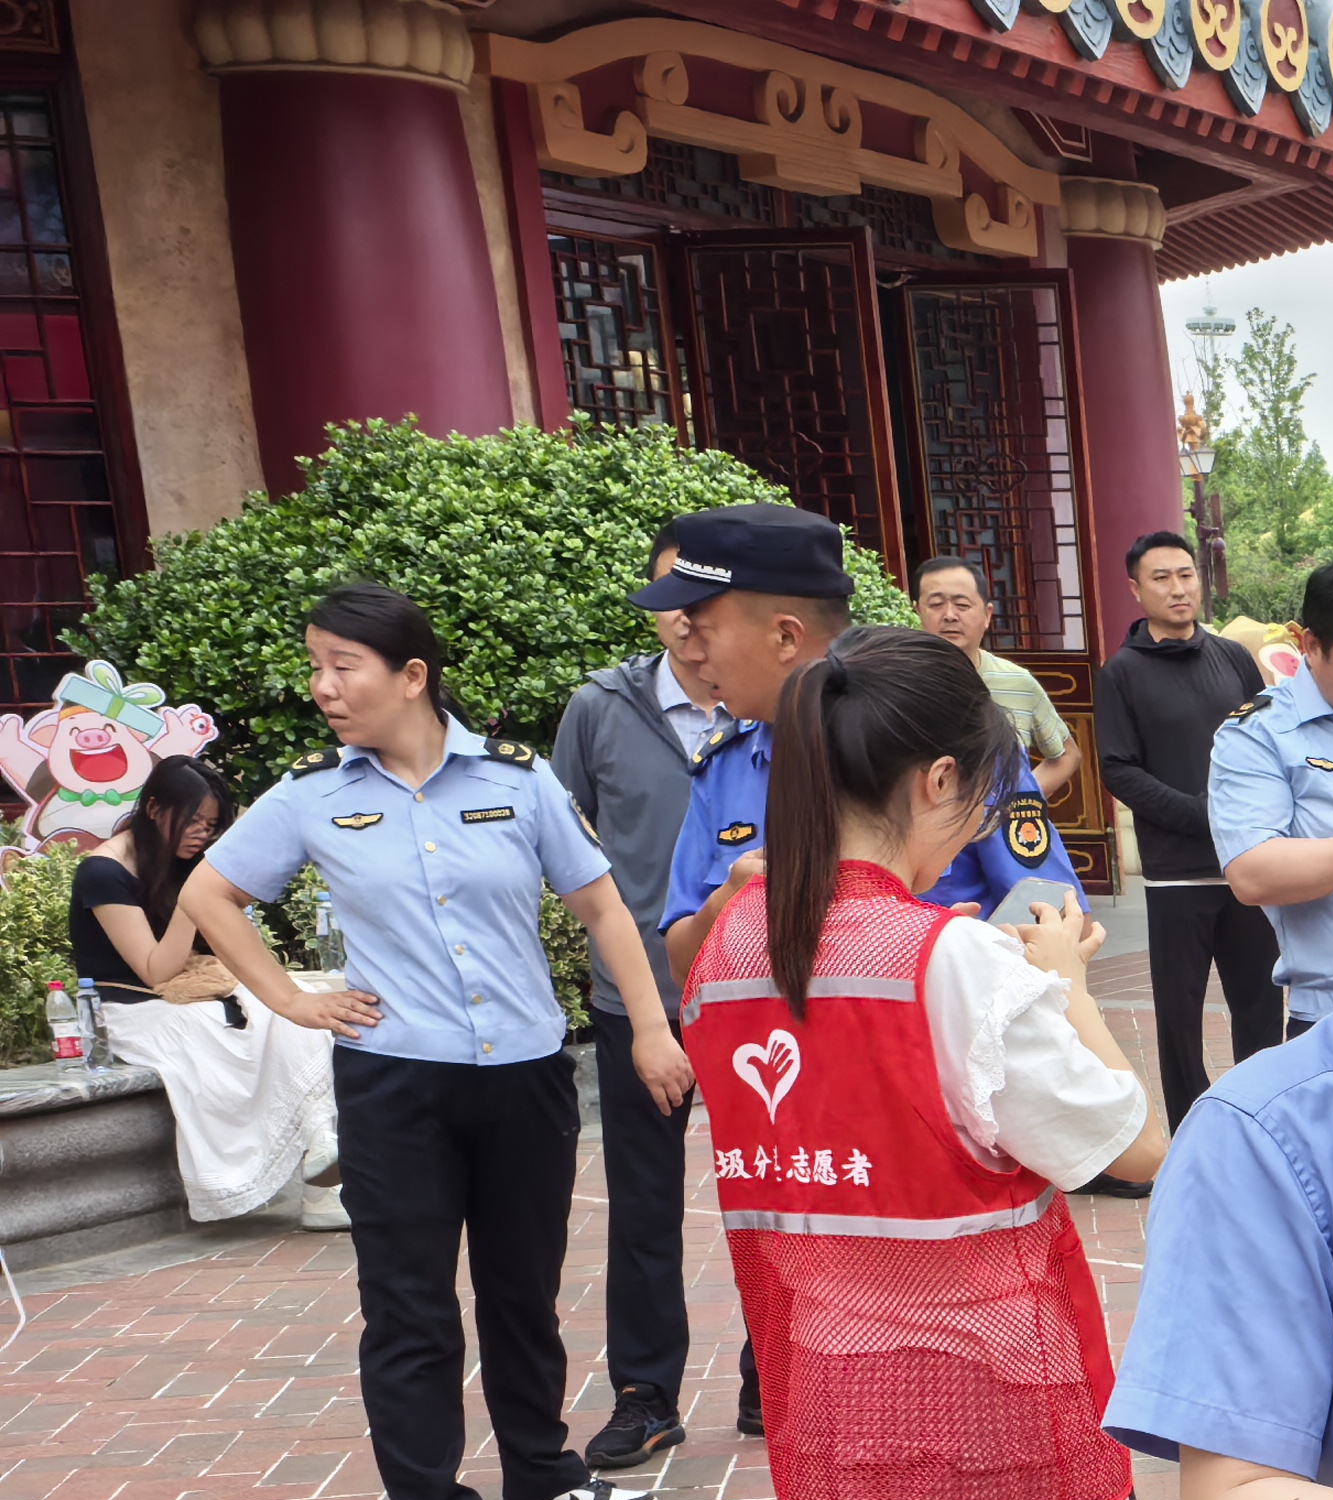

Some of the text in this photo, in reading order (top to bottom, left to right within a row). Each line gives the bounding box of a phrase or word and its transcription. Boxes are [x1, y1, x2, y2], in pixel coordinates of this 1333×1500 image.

[715, 1145, 873, 1187] 圾分志愿者
